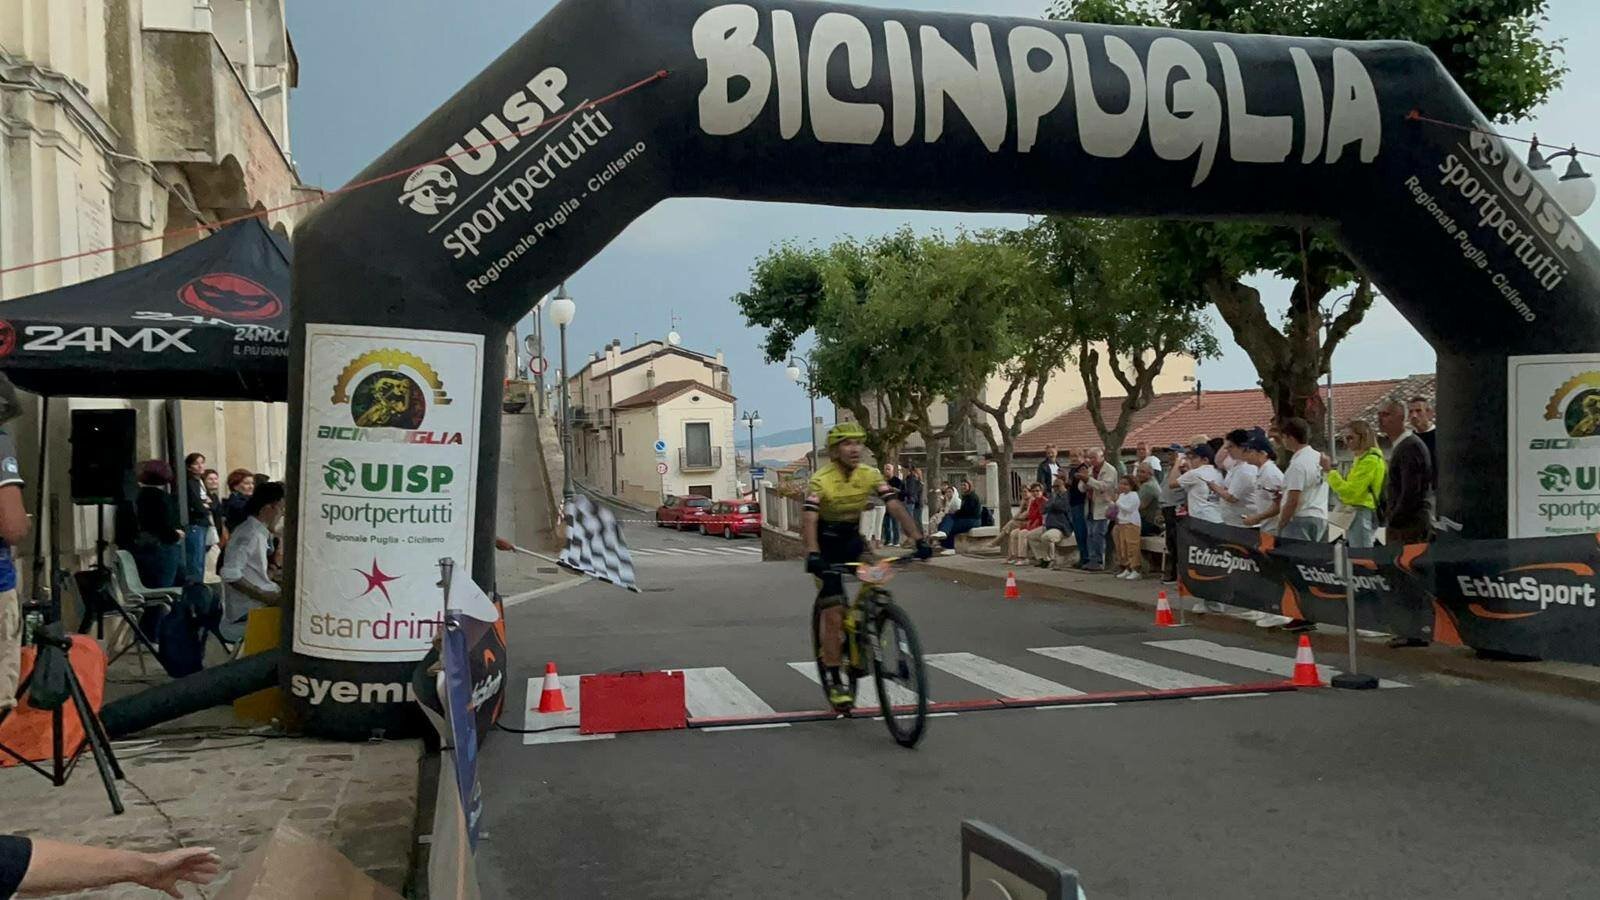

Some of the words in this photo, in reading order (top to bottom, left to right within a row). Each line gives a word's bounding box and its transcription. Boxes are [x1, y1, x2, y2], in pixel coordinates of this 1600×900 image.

[445, 66, 568, 176] UISP
[692, 3, 1382, 188] BICINPUGLIA
[443, 104, 613, 259] sportpertutti
[1502, 160, 1584, 252] UISP
[465, 235, 537, 294] Regionale
[534, 198, 581, 237] Puglia
[587, 140, 647, 193] Ciclismo
[1404, 175, 1458, 234] Regionale
[1453, 230, 1488, 269] Puglia
[1491, 273, 1537, 323] Ciclismo
[1438, 154, 1568, 291] sportpertutti
[23, 326, 196, 353] 24MX
[361, 462, 453, 494] UISP
[320, 501, 452, 529] sportpertutti
[325, 531, 368, 544] Regionale
[370, 534, 399, 546] Puglia
[1188, 545, 1261, 575] EthicSport
[1296, 563, 1392, 593] Ethicport
[1457, 575, 1597, 611] EthicSport
